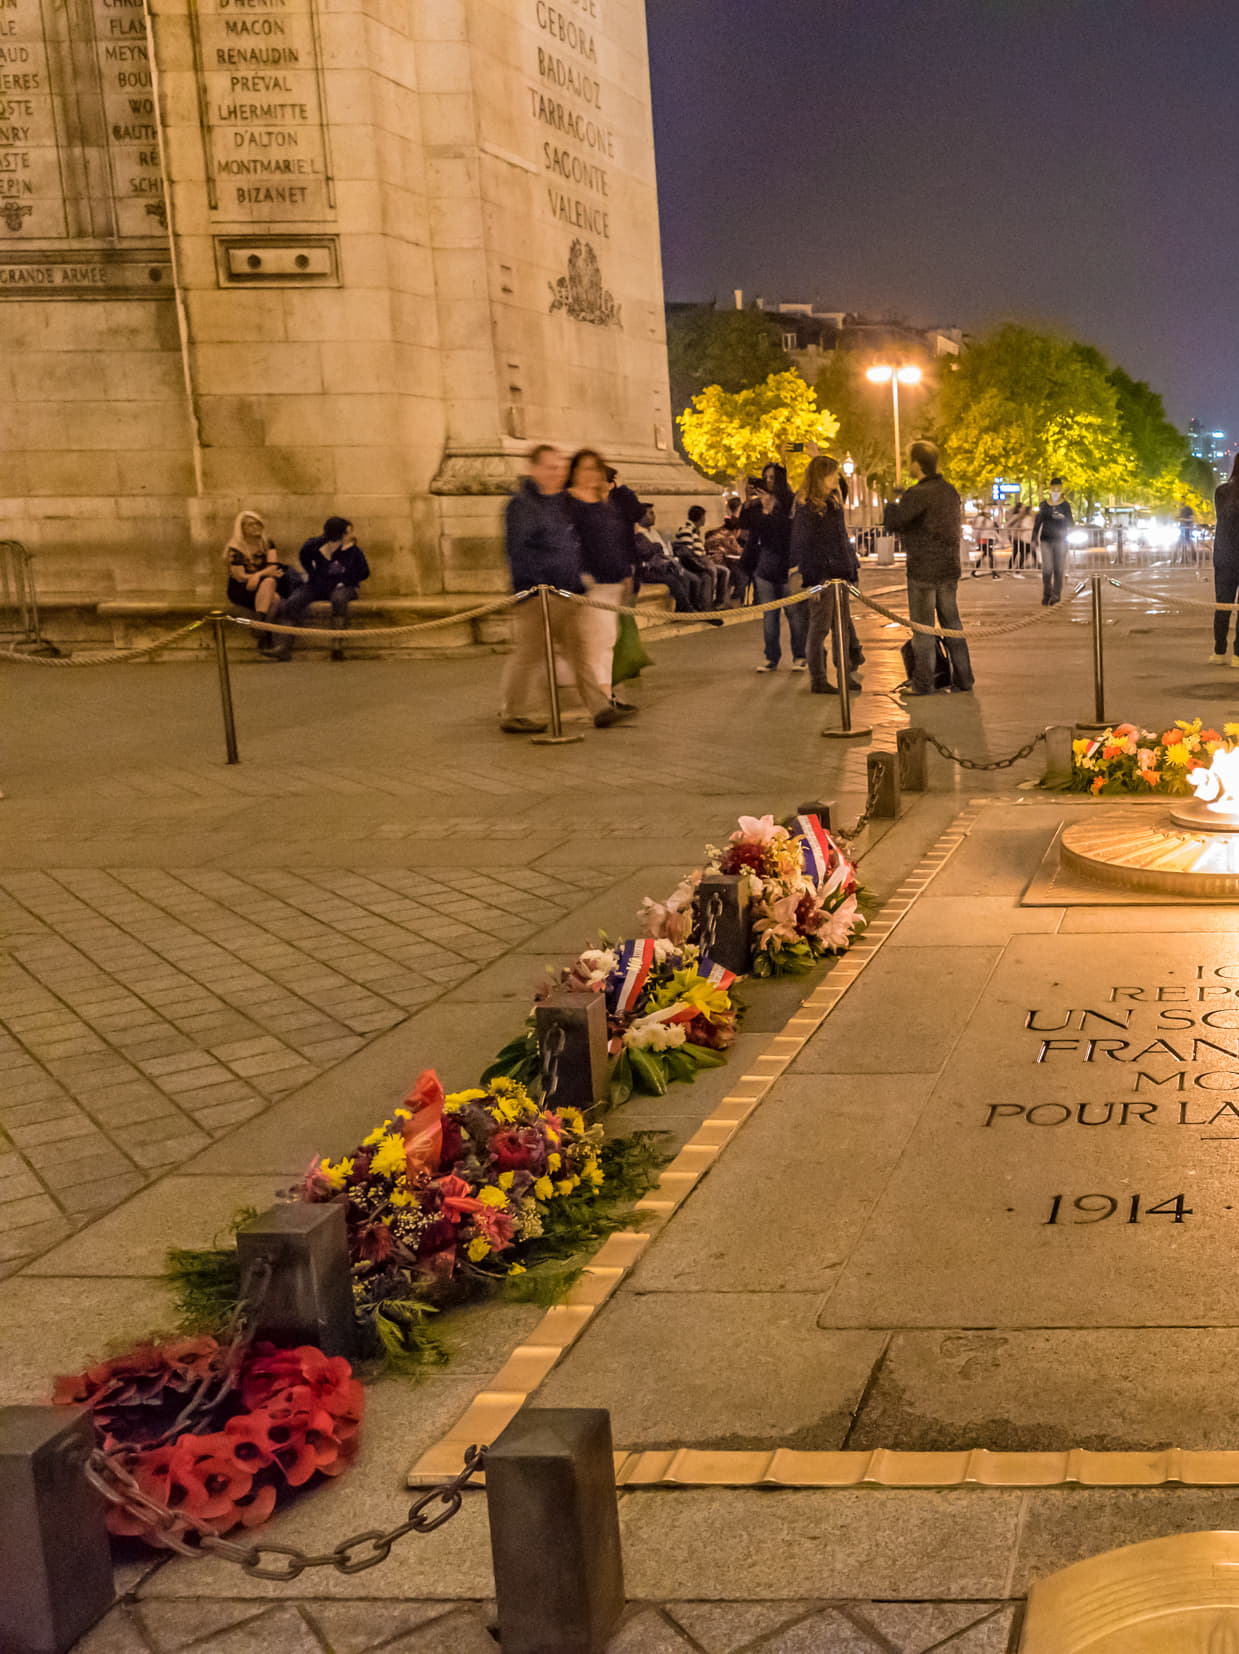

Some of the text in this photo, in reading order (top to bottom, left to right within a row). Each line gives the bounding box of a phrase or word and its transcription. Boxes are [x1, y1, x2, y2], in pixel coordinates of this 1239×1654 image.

[225, 19, 285, 36] MACON
[216, 47, 299, 65] RENAUDIN
[537, 46, 602, 110] BADAJOZ
[218, 104, 309, 121] LHERMITTE
[236, 187, 307, 204] BIZANET
[548, 188, 610, 239] VALENCE
[1024, 1008, 1133, 1032] UN
[982, 1101, 1159, 1127] POUR
[1043, 1193, 1195, 1225] 1914
